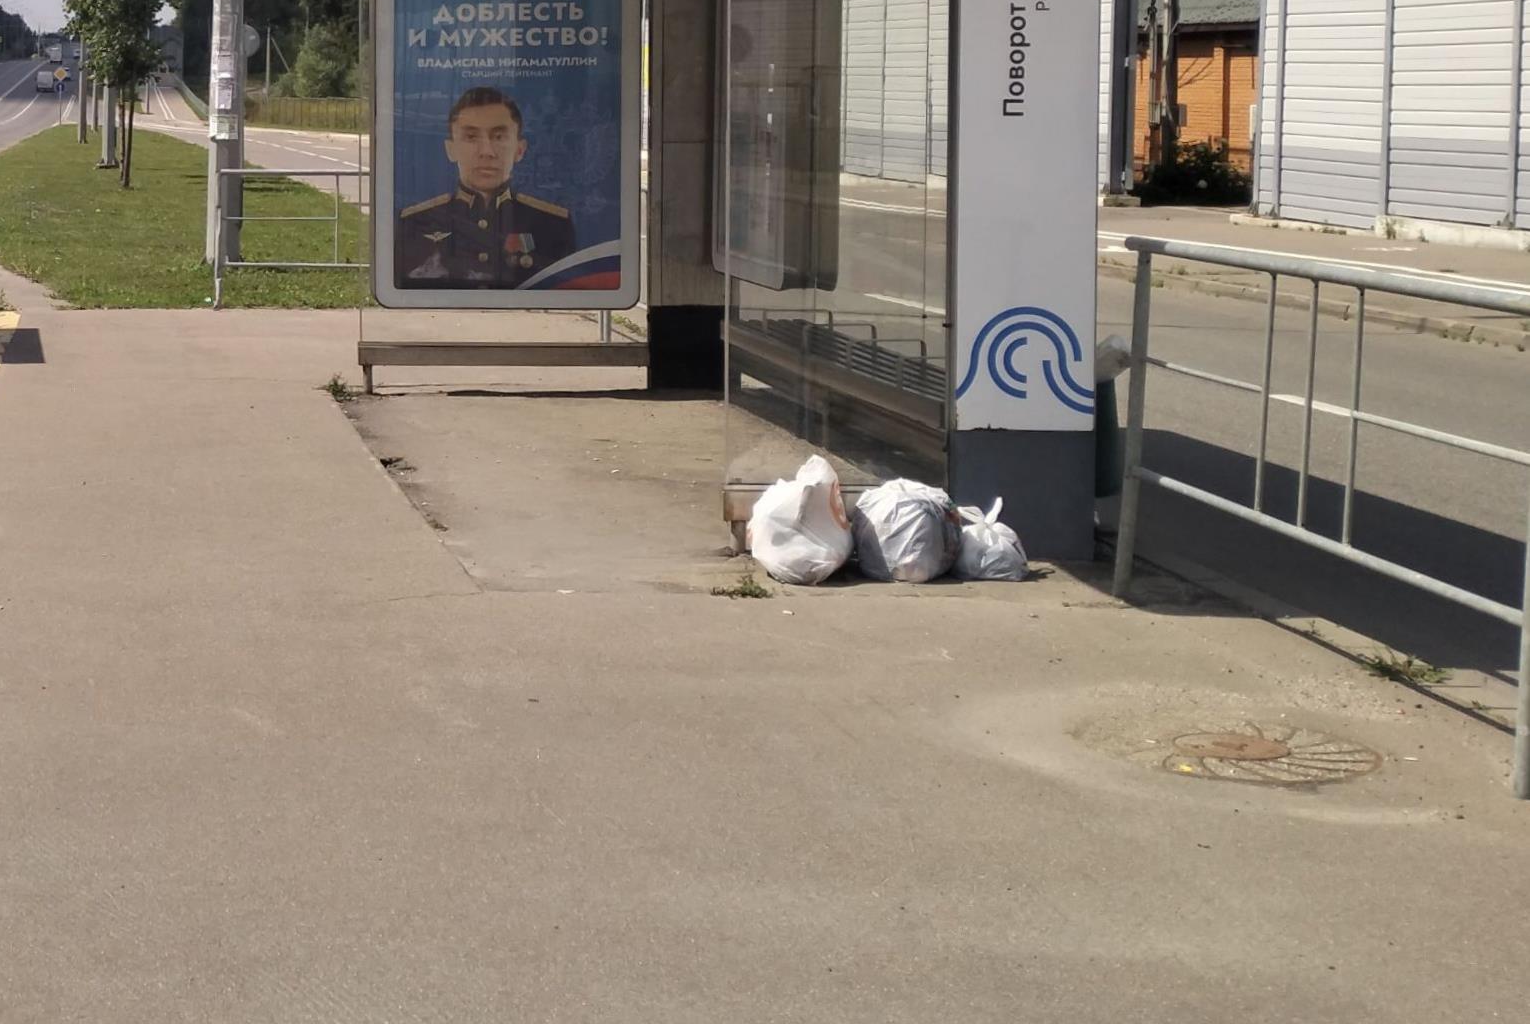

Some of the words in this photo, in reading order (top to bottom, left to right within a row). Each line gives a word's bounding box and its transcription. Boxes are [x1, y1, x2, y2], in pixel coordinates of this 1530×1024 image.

[432, 2, 584, 24] ДОБЛЕСТЬ
[408, 28, 427, 47] И
[438, 26, 609, 47] МУЖЕСТВО!
[417, 57, 495, 69] ВЛАДИСЛАВ
[498, 57, 598, 67] НИГАМАТУЛЛИН
[1002, 3, 1031, 117] Поворот
